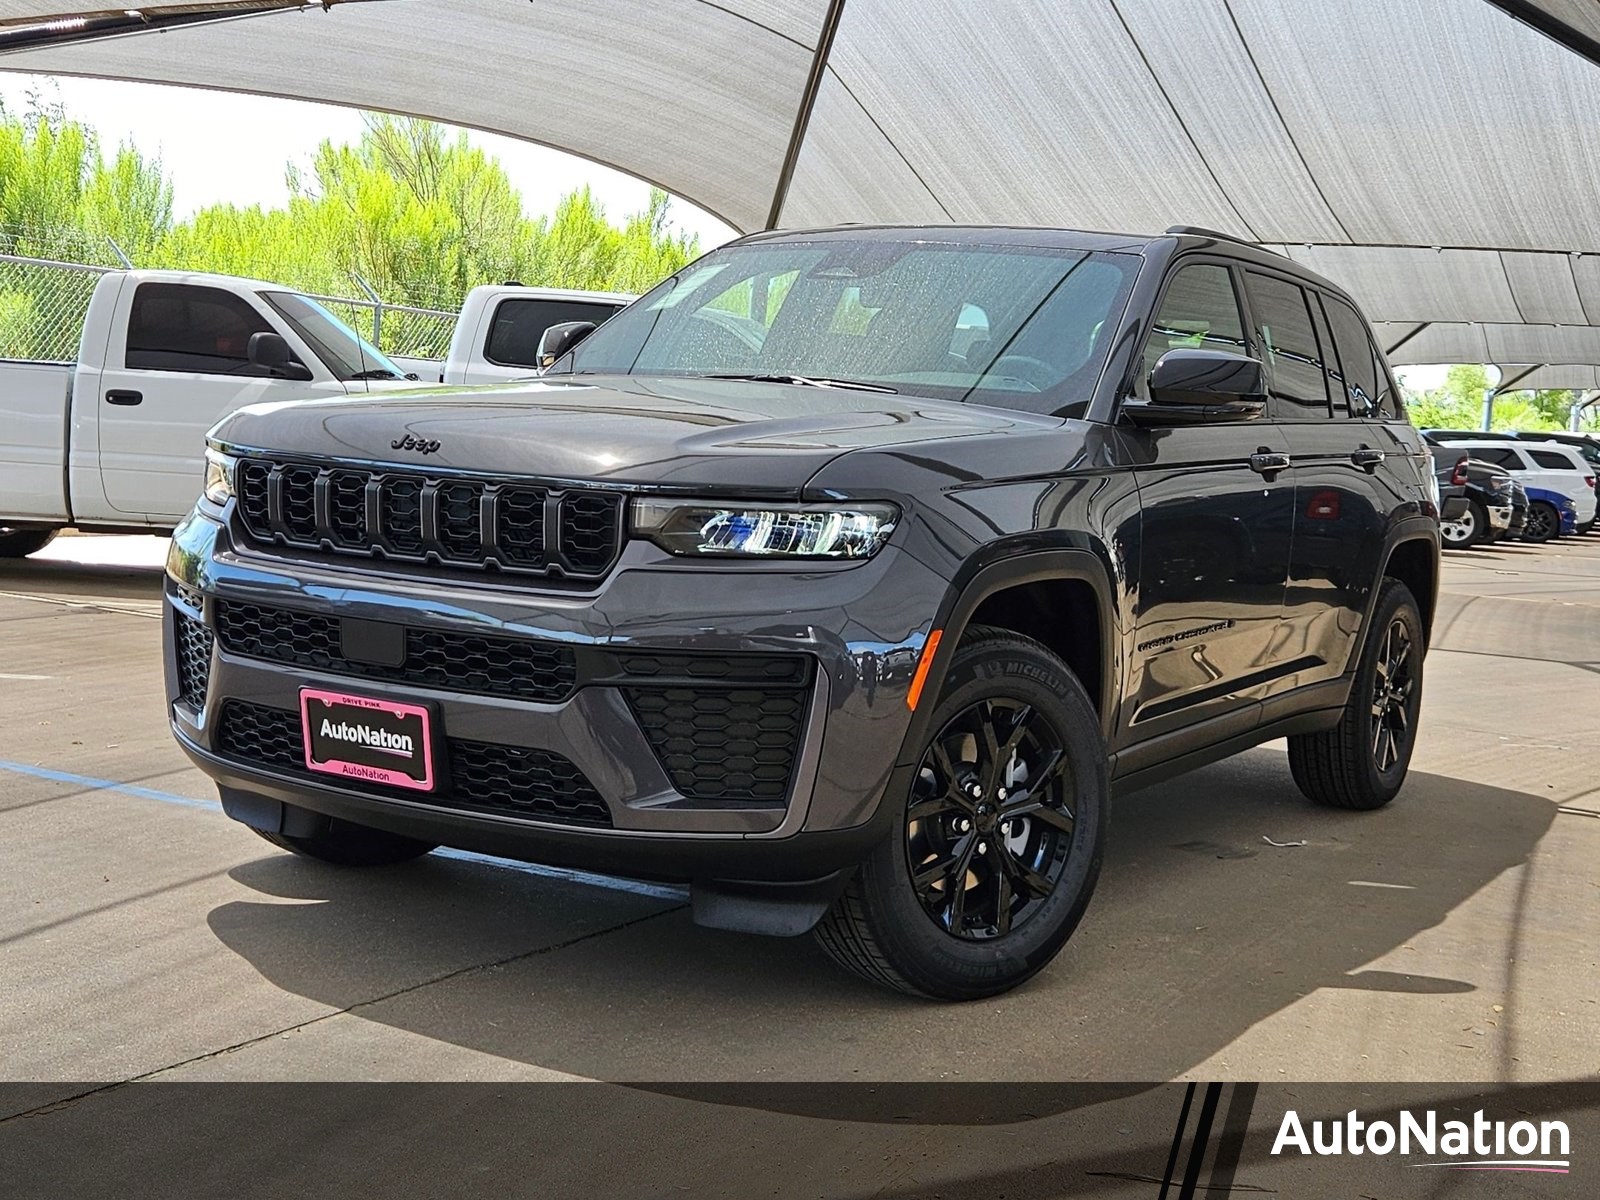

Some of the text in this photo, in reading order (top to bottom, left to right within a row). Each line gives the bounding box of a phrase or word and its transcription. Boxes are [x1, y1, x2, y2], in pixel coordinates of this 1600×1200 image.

[391, 434, 441, 456] Jeep
[1006, 662, 1068, 697] MICHELIN
[342, 697, 381, 708] DRIVE PINK
[320, 718, 413, 751] AutoNation
[342, 764, 390, 782] AutoNation
